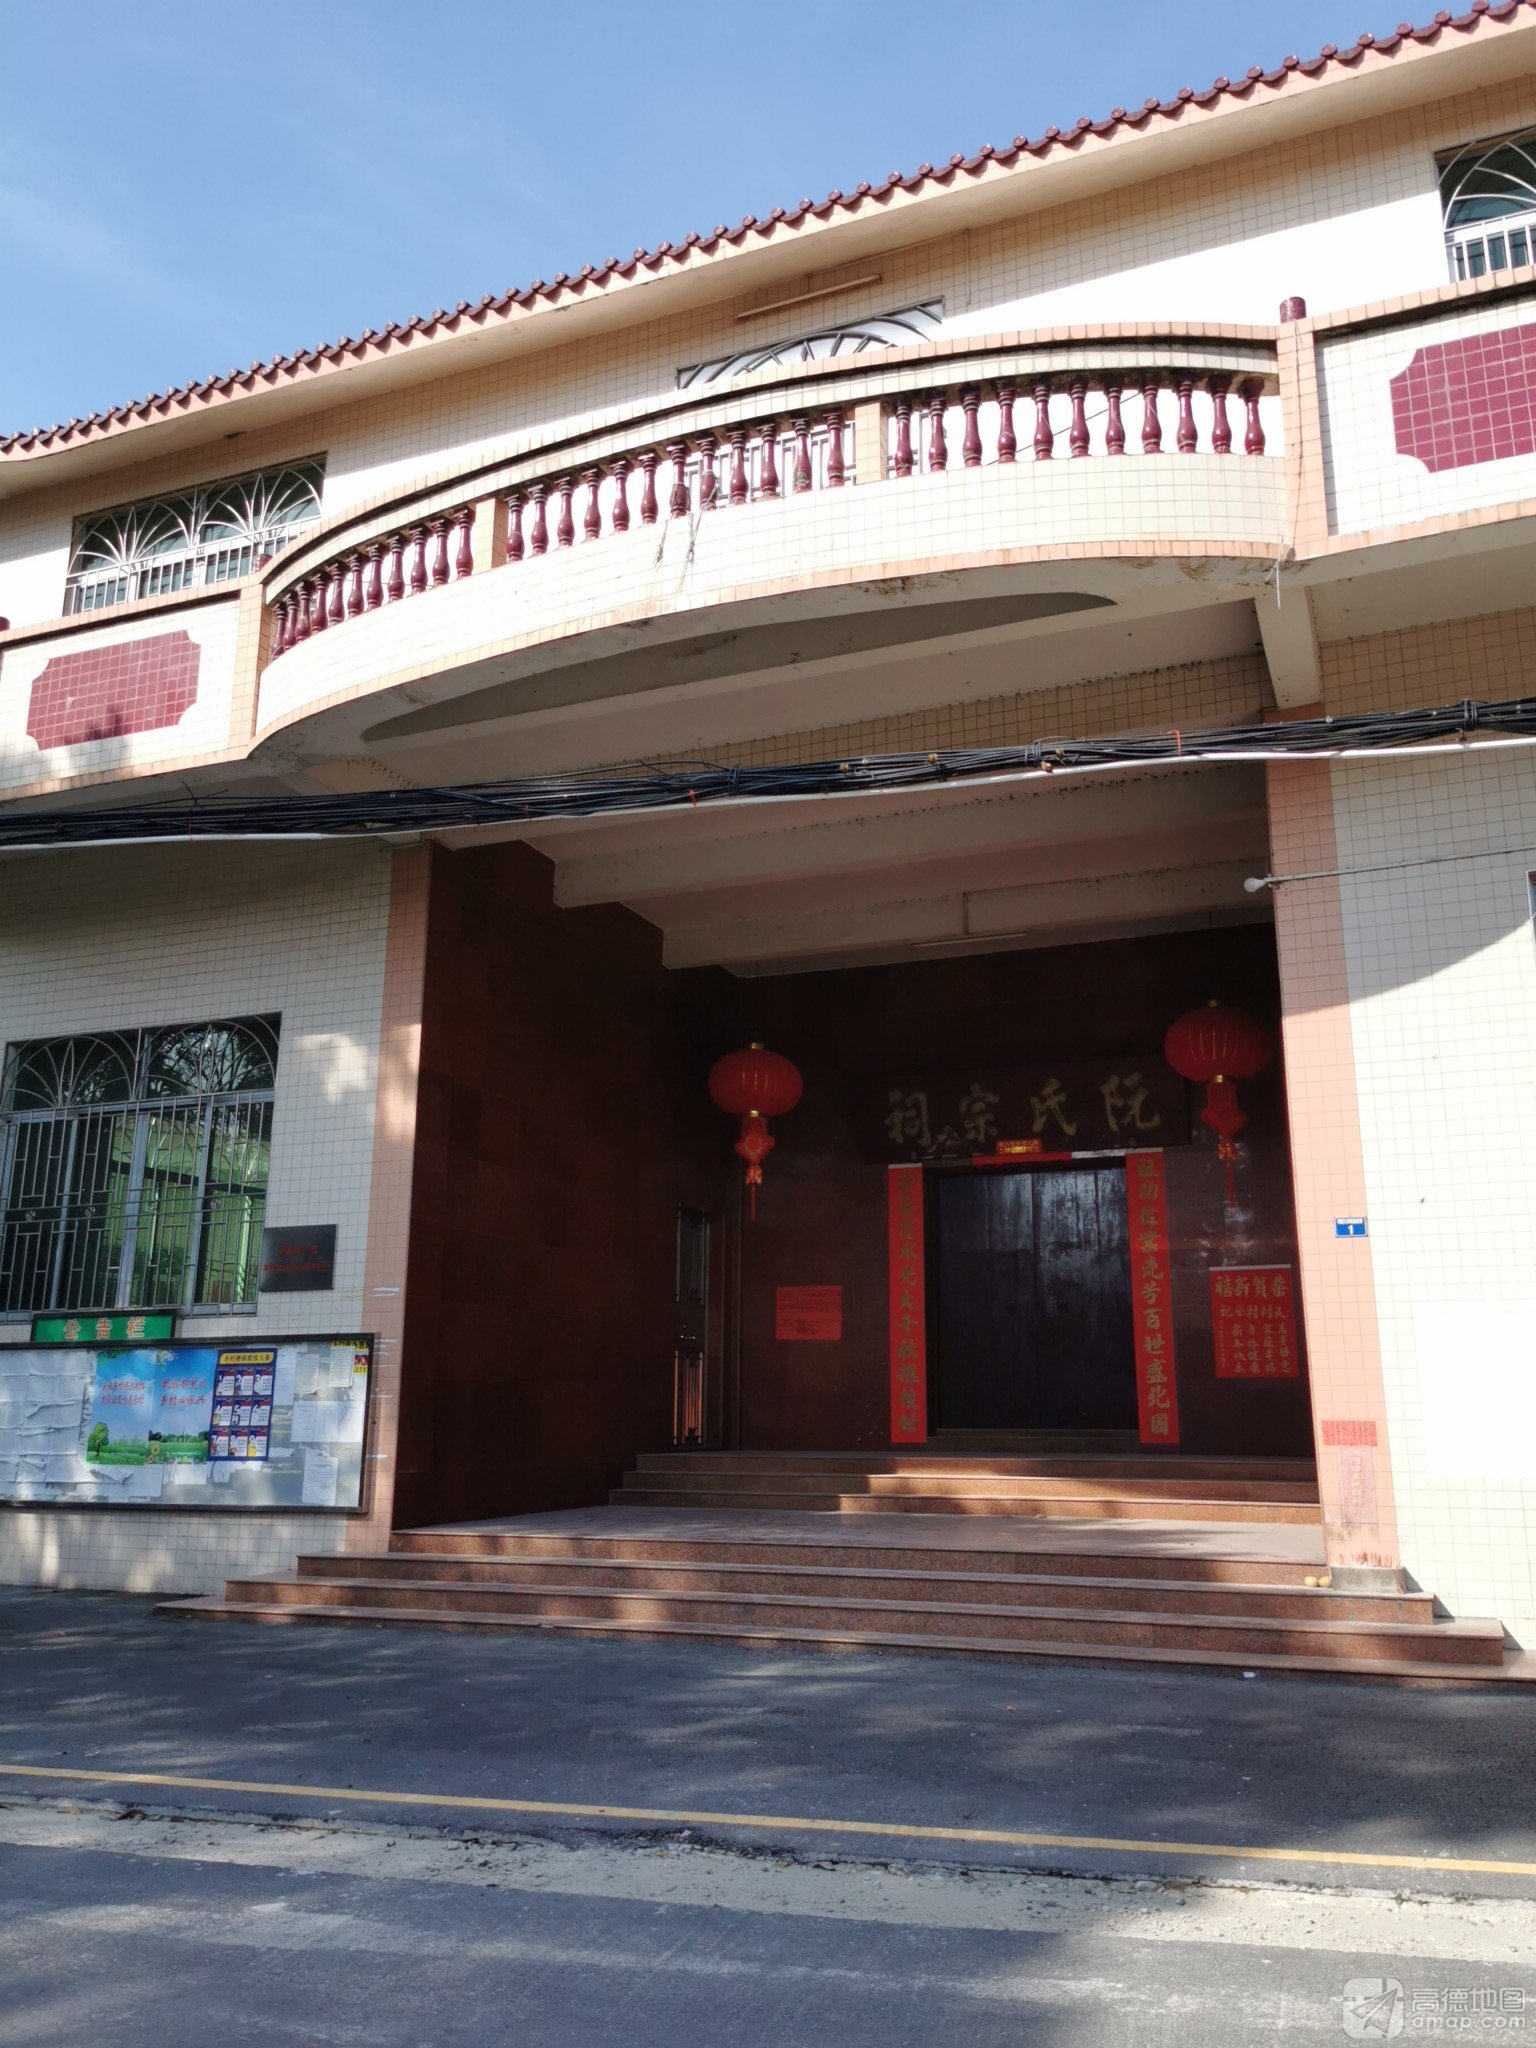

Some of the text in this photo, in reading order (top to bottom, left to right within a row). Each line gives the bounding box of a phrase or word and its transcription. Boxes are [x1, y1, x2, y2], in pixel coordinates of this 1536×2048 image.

[1347, 1224, 1354, 1235] 1
[63, 1316, 146, 1340] 公告栏
